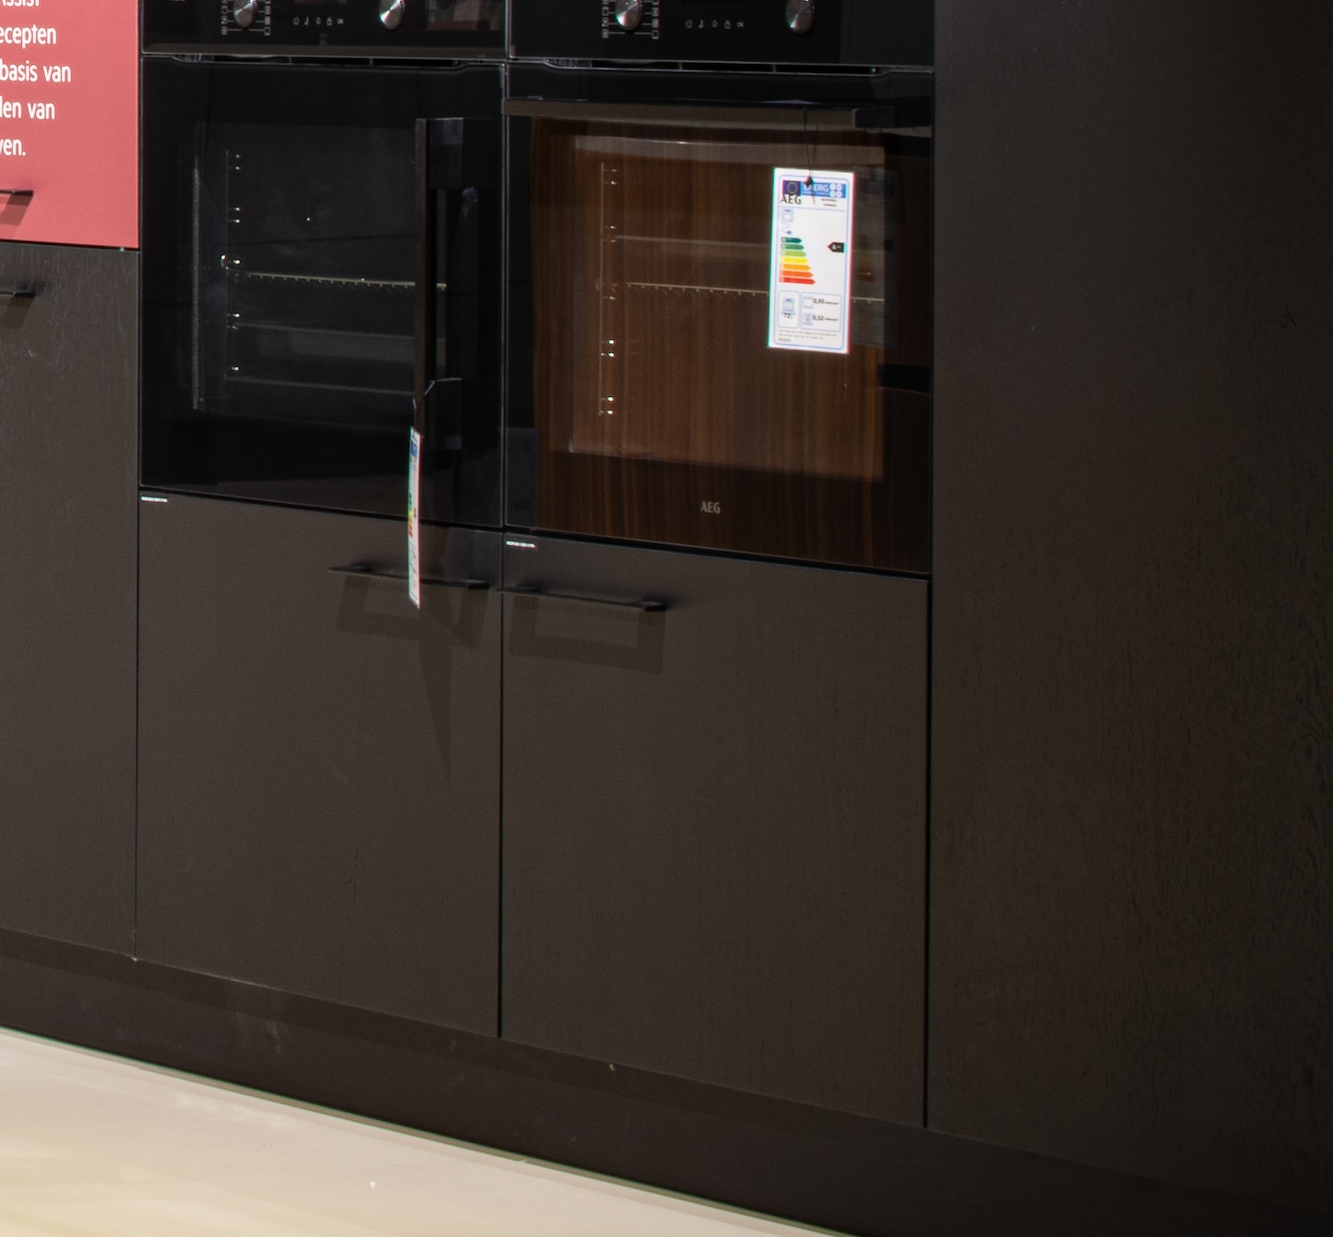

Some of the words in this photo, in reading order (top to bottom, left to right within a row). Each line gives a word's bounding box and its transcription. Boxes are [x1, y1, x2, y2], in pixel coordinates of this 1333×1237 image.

[43, 64, 72, 83] van
[27, 101, 56, 120] van
[780, 193, 802, 205] AEG
[700, 500, 722, 514] AEG
